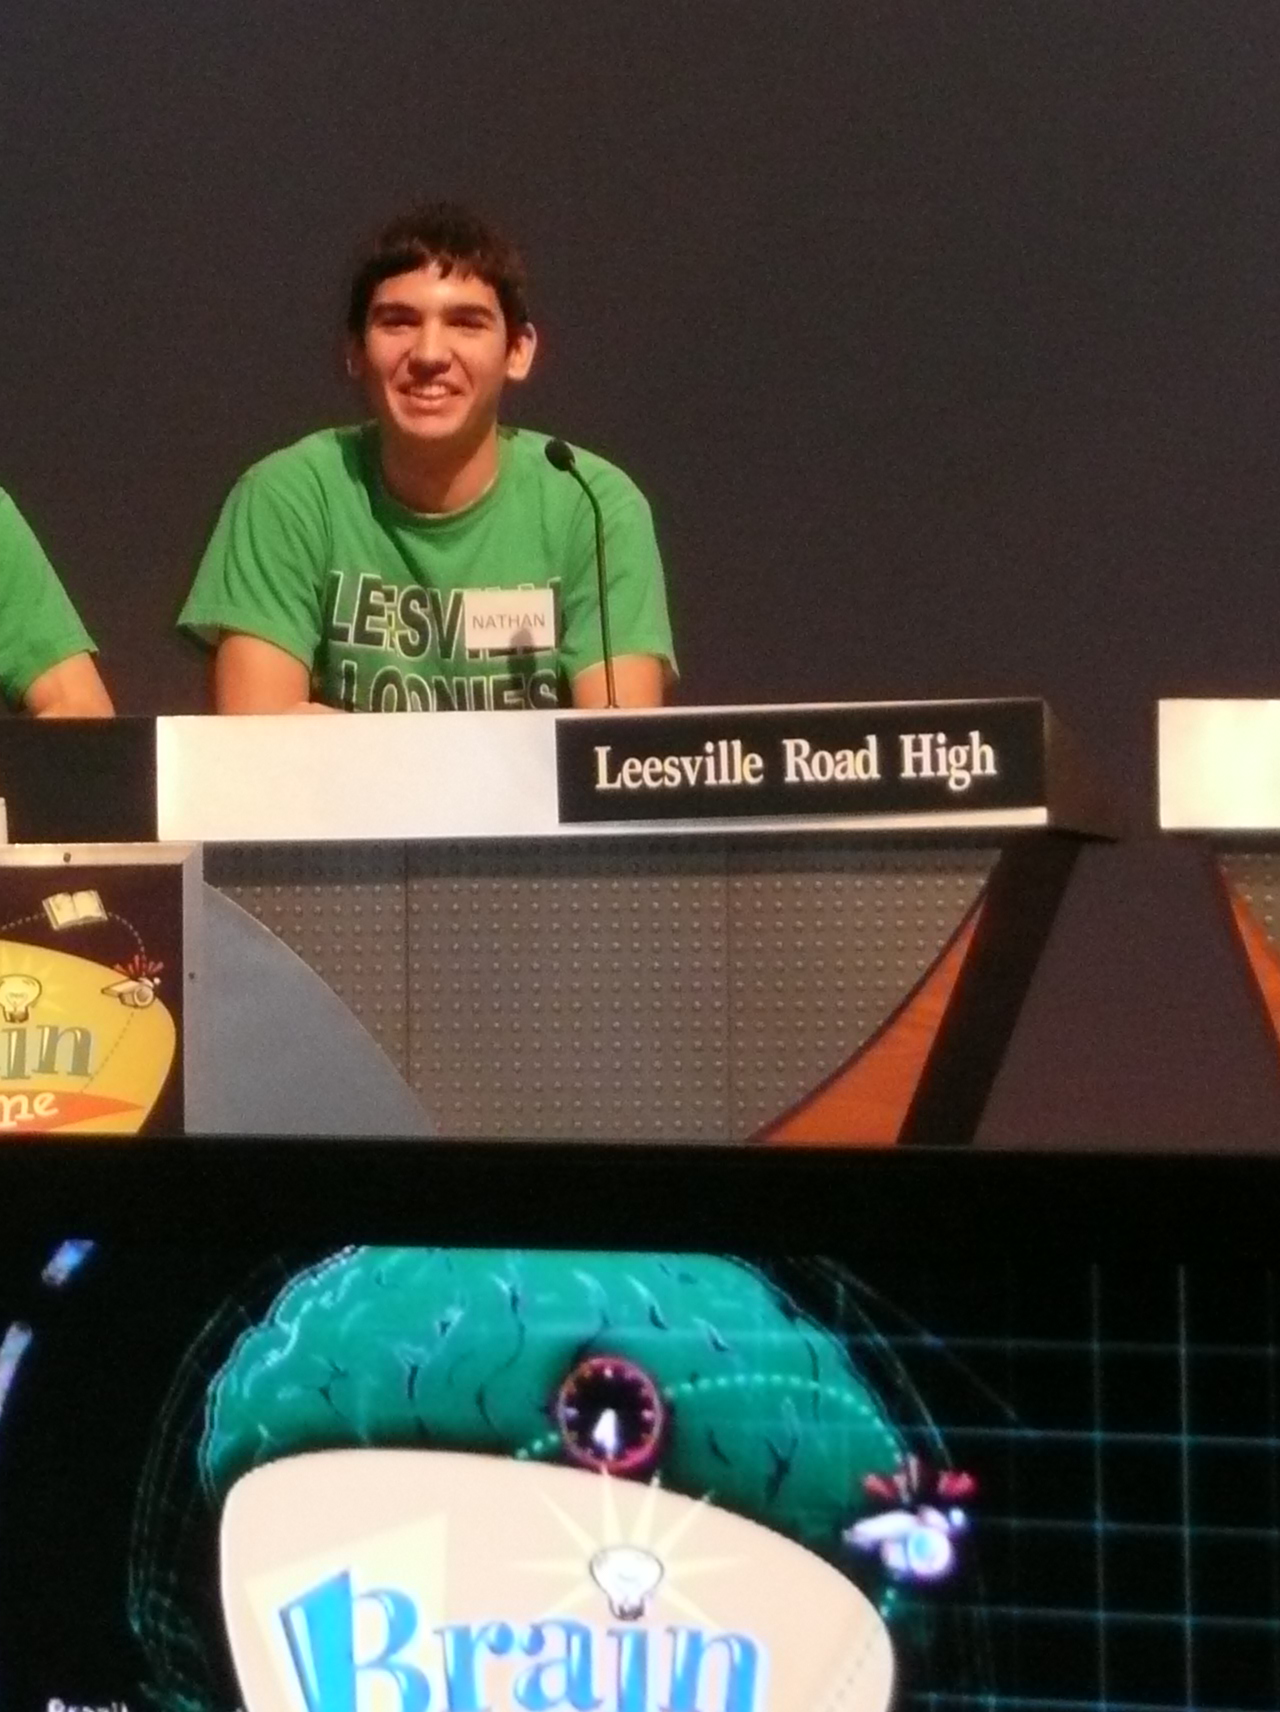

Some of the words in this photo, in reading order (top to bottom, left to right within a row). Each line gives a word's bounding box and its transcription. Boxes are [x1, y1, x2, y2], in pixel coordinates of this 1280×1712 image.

[471, 612, 546, 630] NATHAN
[594, 738, 764, 790] Leesville
[782, 734, 881, 783] Road
[900, 730, 998, 792] High
[278, 1568, 761, 1712] Brain
